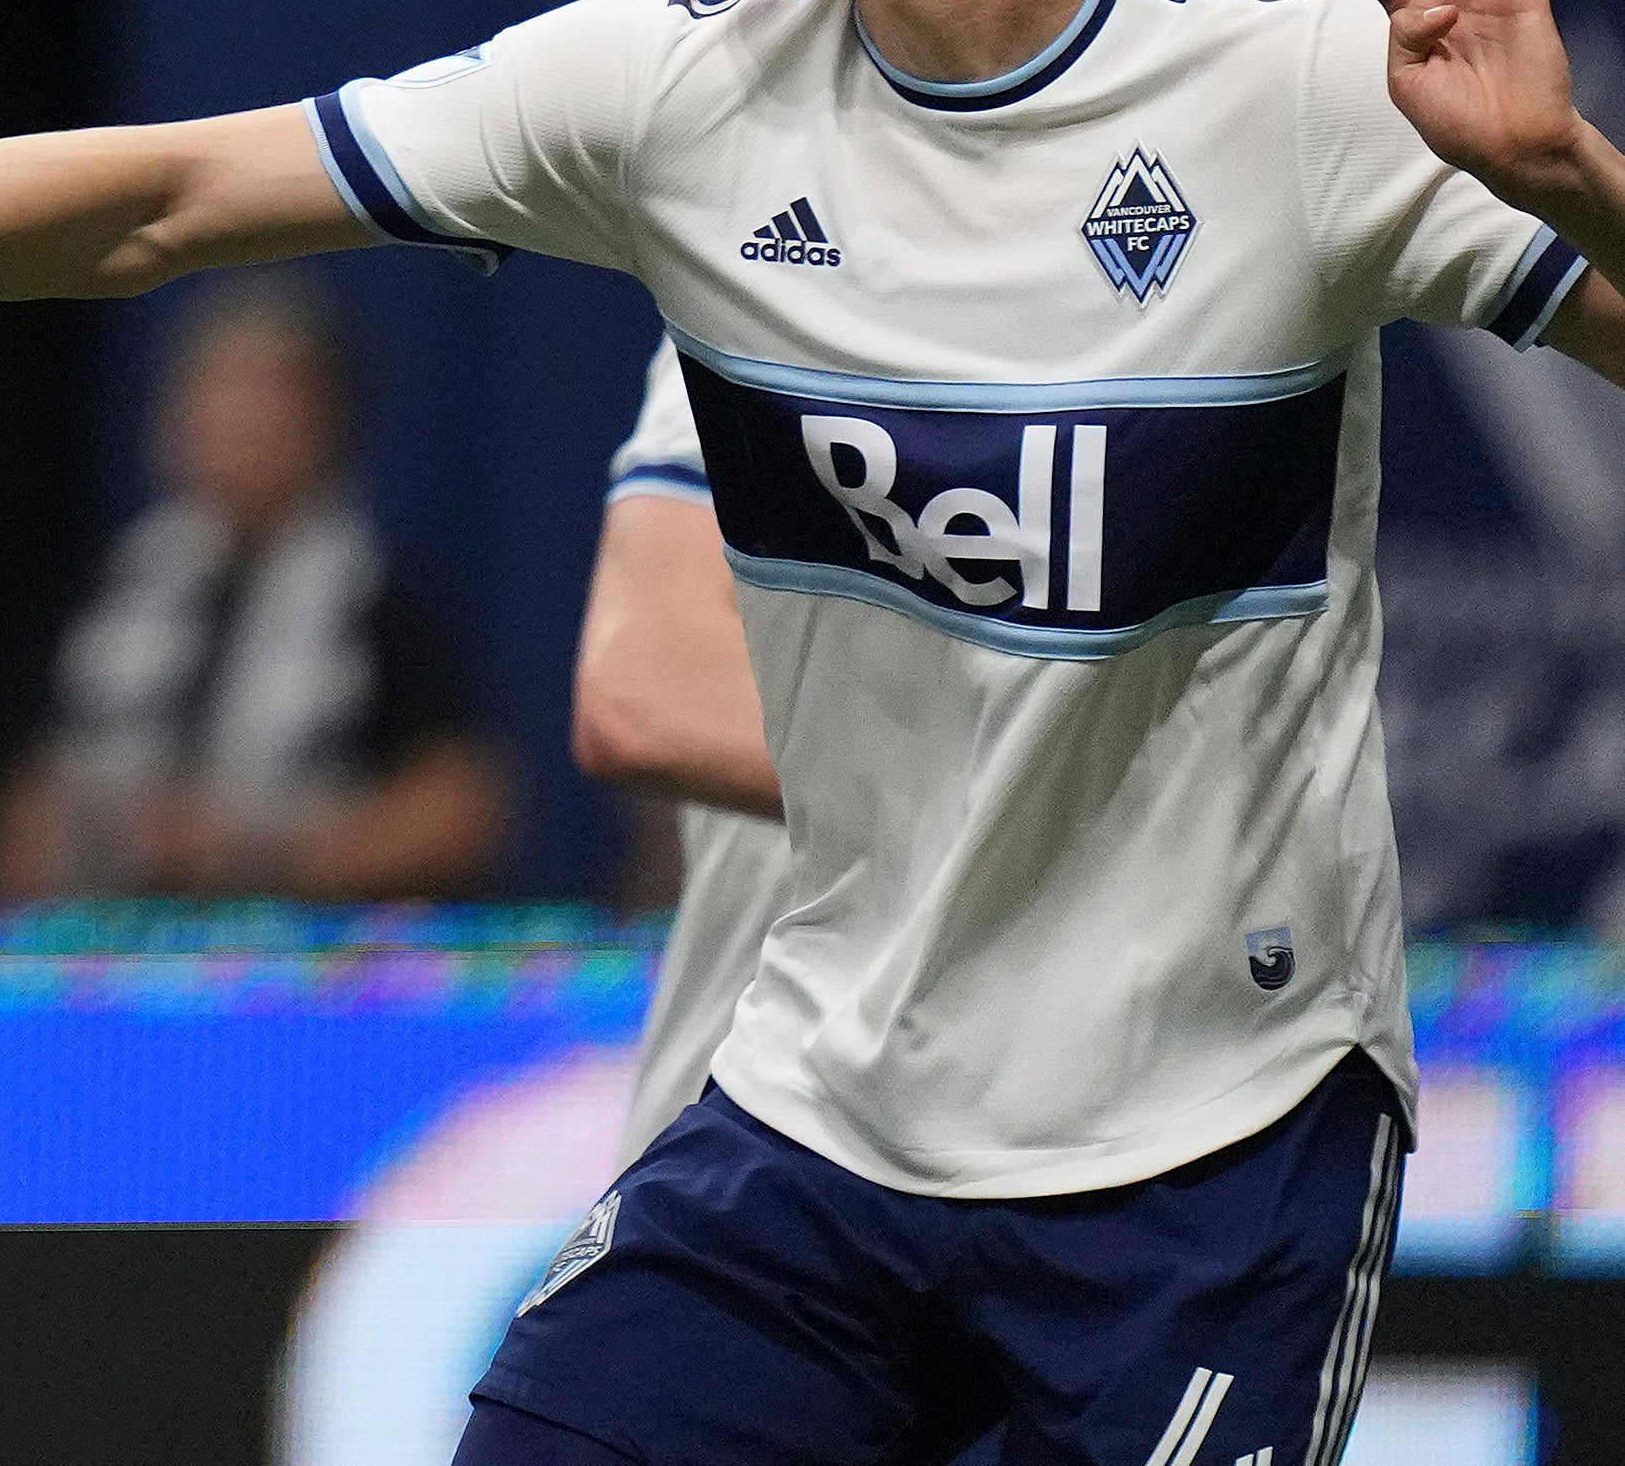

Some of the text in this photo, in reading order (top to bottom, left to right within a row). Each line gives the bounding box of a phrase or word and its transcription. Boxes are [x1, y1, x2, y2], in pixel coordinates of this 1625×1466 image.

[1106, 204, 1172, 218] VANCOUVER
[1086, 214, 1191, 246] WHITECAPS
[1127, 235, 1150, 252] FC
[740, 236, 841, 267] adidas
[800, 414, 1108, 612] Bell
